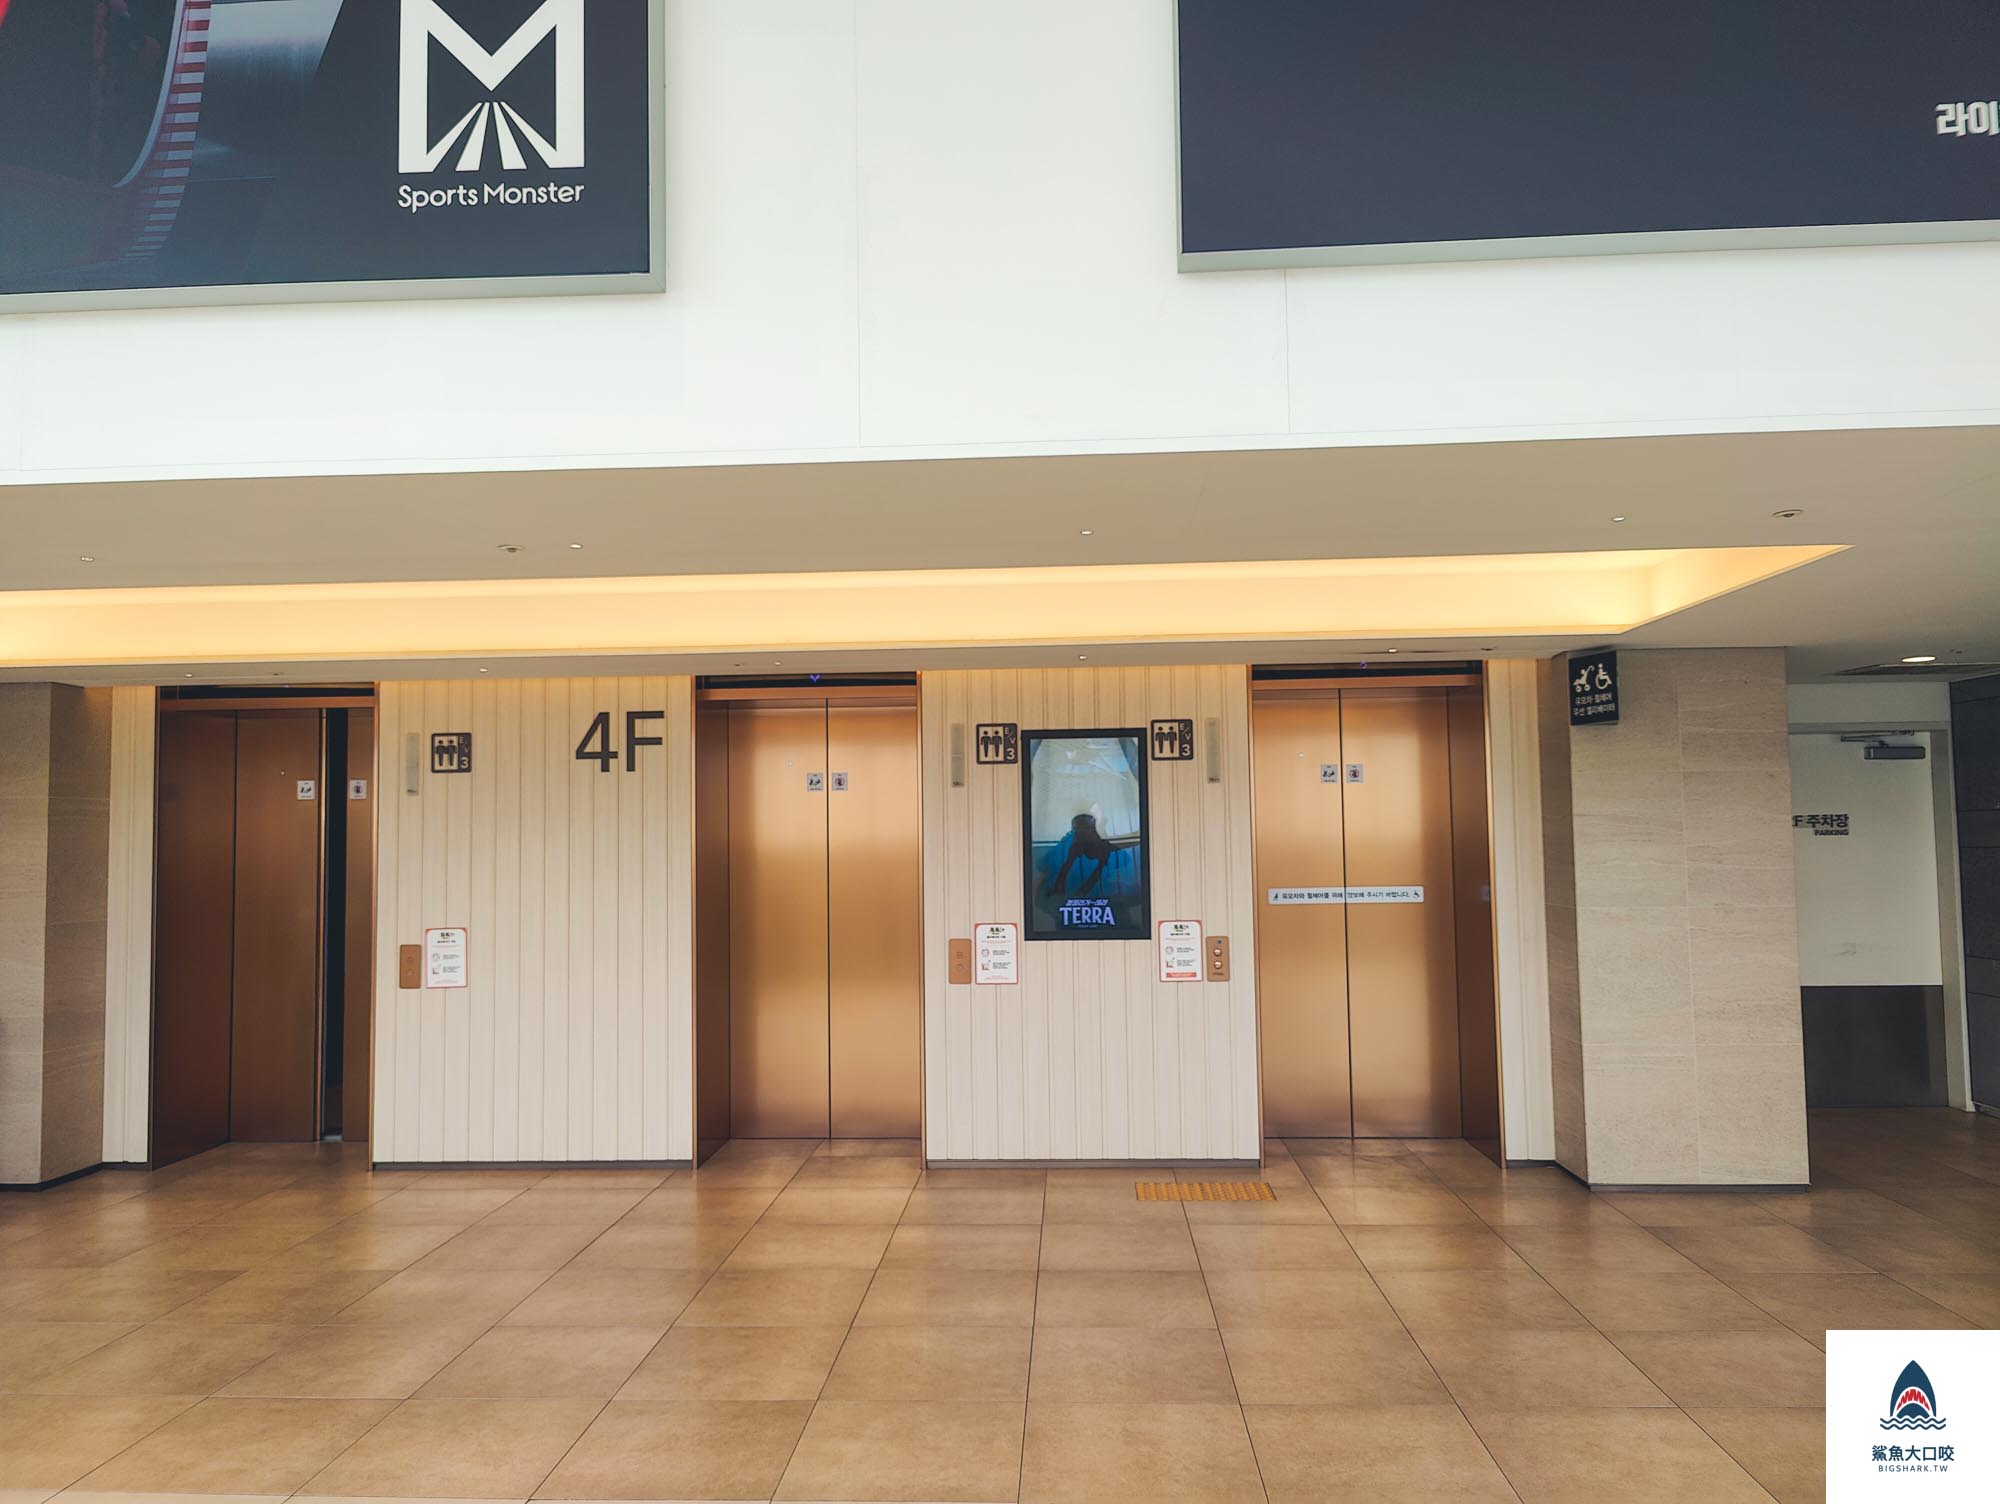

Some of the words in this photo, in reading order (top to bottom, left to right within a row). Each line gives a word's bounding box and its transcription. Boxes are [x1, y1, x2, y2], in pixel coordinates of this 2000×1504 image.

[1935, 100, 2000, 136] 라이
[397, 184, 478, 214] Sports
[483, 181, 585, 205] Monster
[575, 710, 665, 772] 4F
[1006, 747, 1015, 760] 3
[1181, 744, 1191, 756] 3
[460, 756, 469, 769] 3
[1806, 814, 1849, 828] 주차장
[1059, 906, 1116, 926] TERRA
